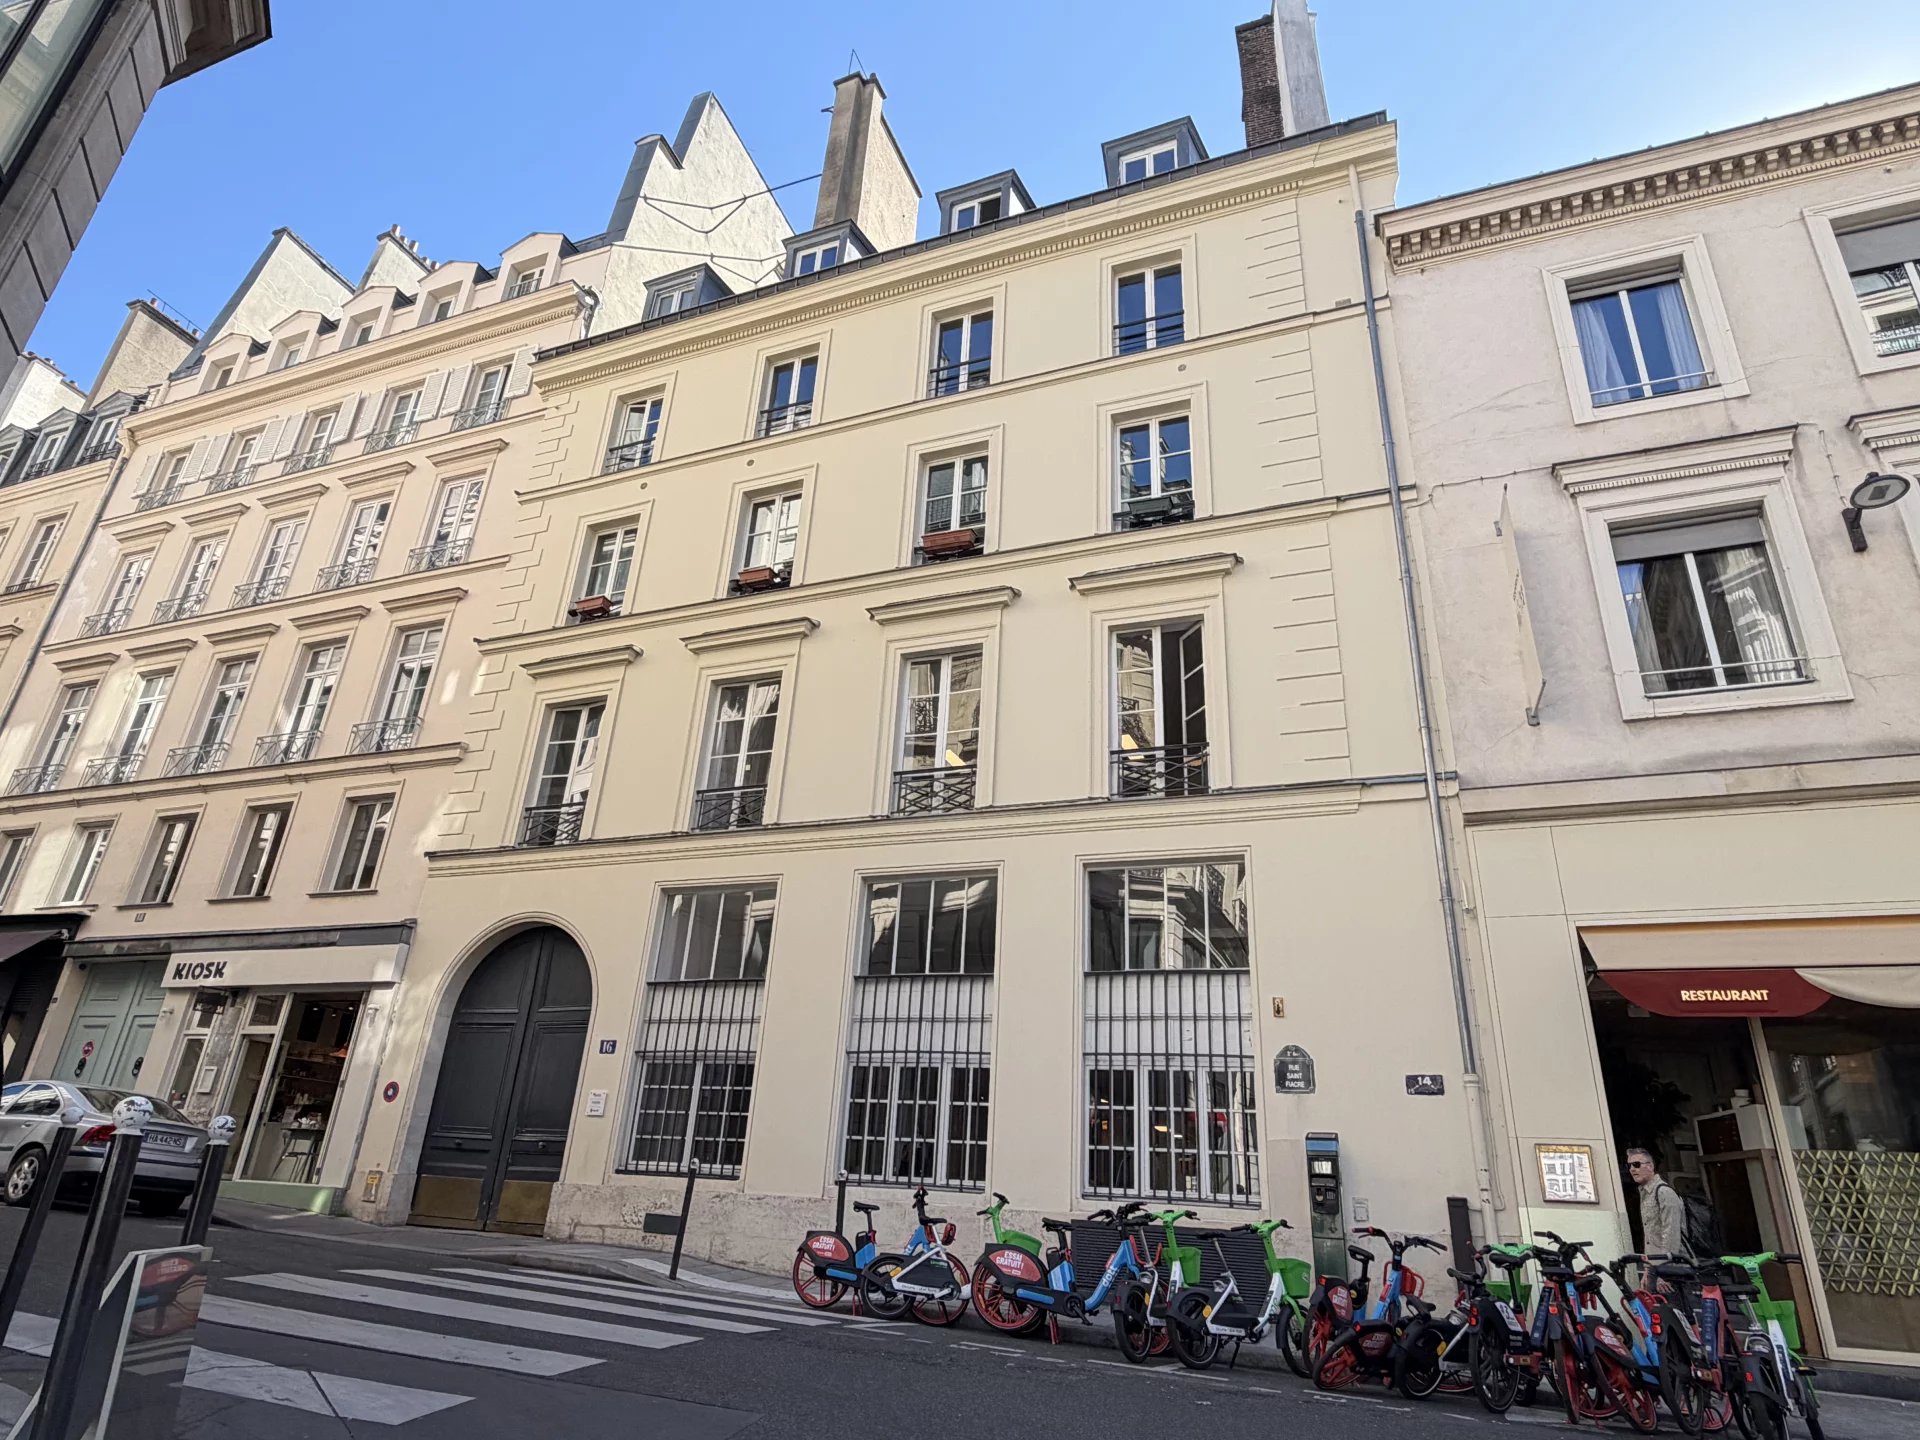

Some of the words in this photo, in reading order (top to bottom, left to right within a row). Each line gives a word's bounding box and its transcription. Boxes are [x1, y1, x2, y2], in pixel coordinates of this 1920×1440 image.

[172, 961, 228, 980] KIOSK
[1680, 990, 1769, 1001] RESTAURANT
[602, 1041, 613, 1053] 16
[1285, 1080, 1305, 1088] FIACRE
[1417, 1076, 1432, 1086] 14
[1004, 1251, 1023, 1261] ESSAI
